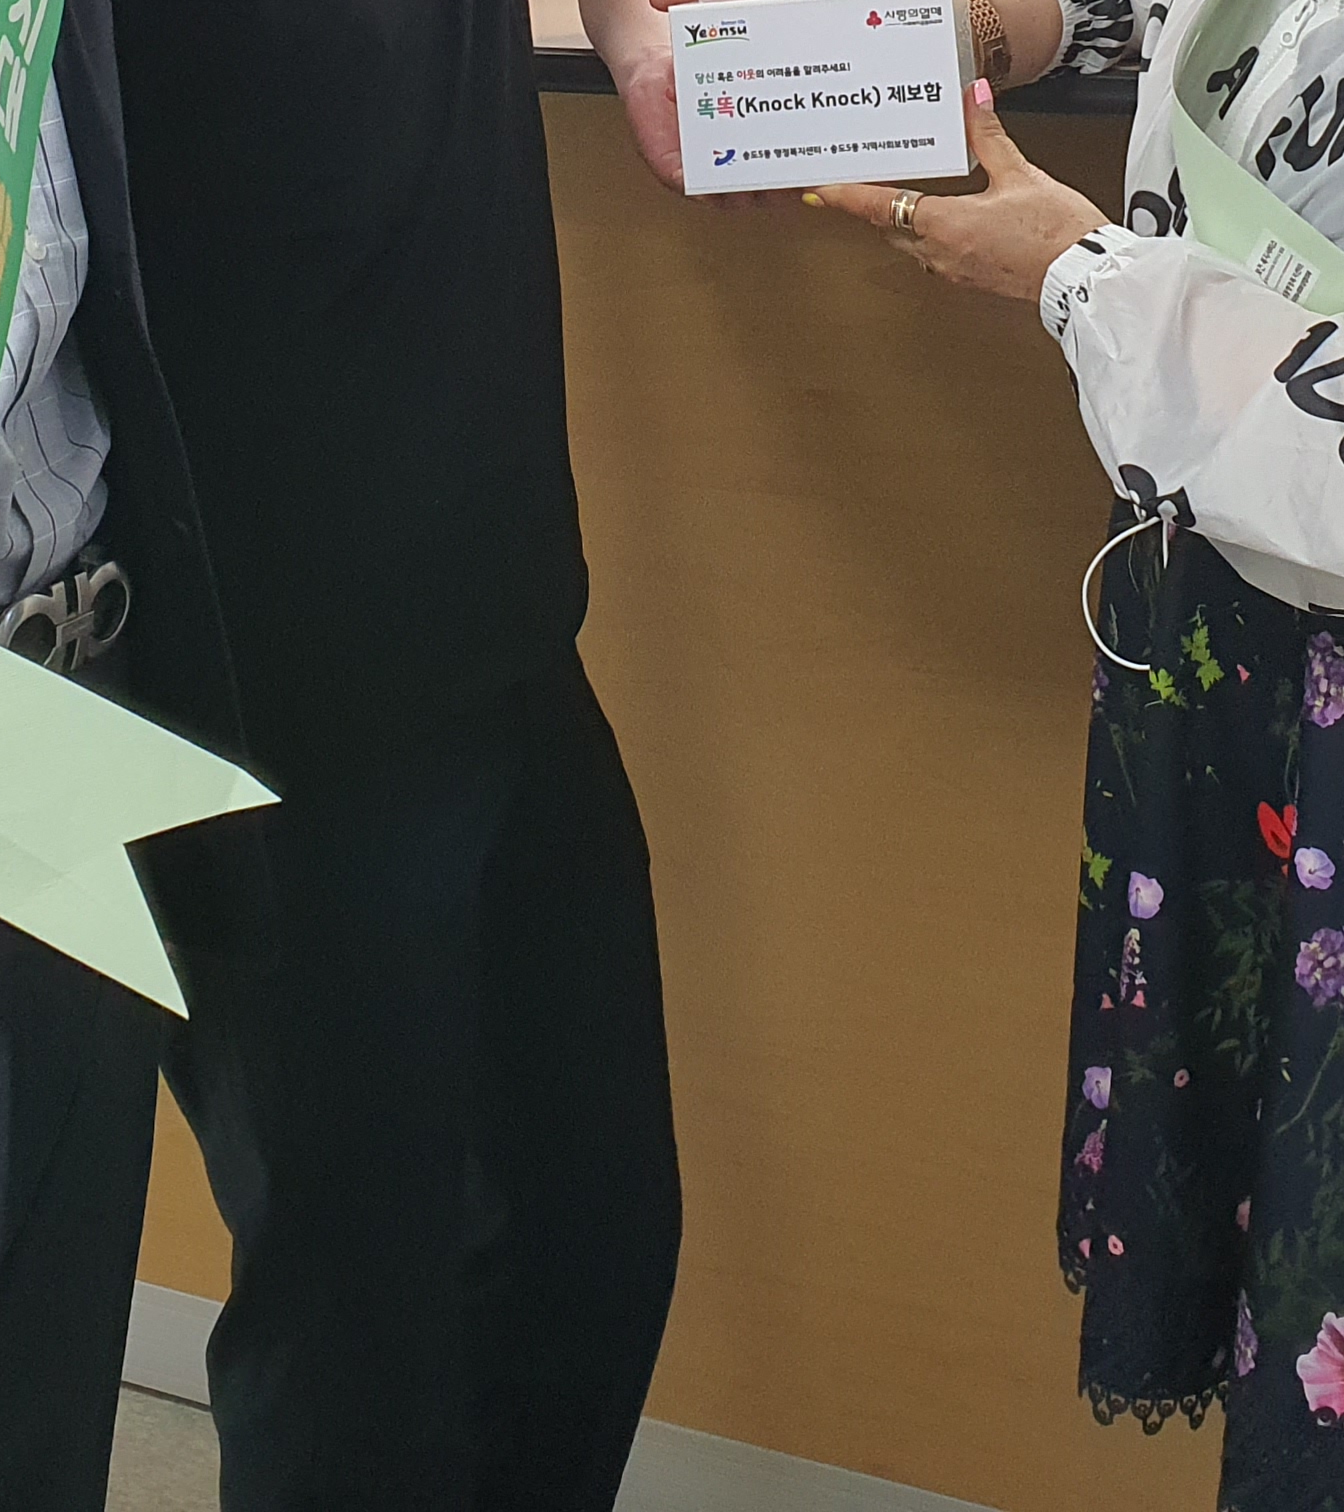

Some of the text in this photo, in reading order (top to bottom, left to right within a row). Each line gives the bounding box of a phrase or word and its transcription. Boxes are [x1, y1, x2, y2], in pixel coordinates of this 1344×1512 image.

[884, 7, 943, 22] 사랑의열매
[684, 23, 747, 43] Yeonsu
[695, 62, 851, 85] 당신 혹은 이웃의 어려움을 알려주세요!
[811, 86, 881, 108] Knock)
[887, 82, 943, 103] 제보함
[742, 137, 936, 161] 송도5동 행정복지센터 송도5동 지역사회보장협의체
